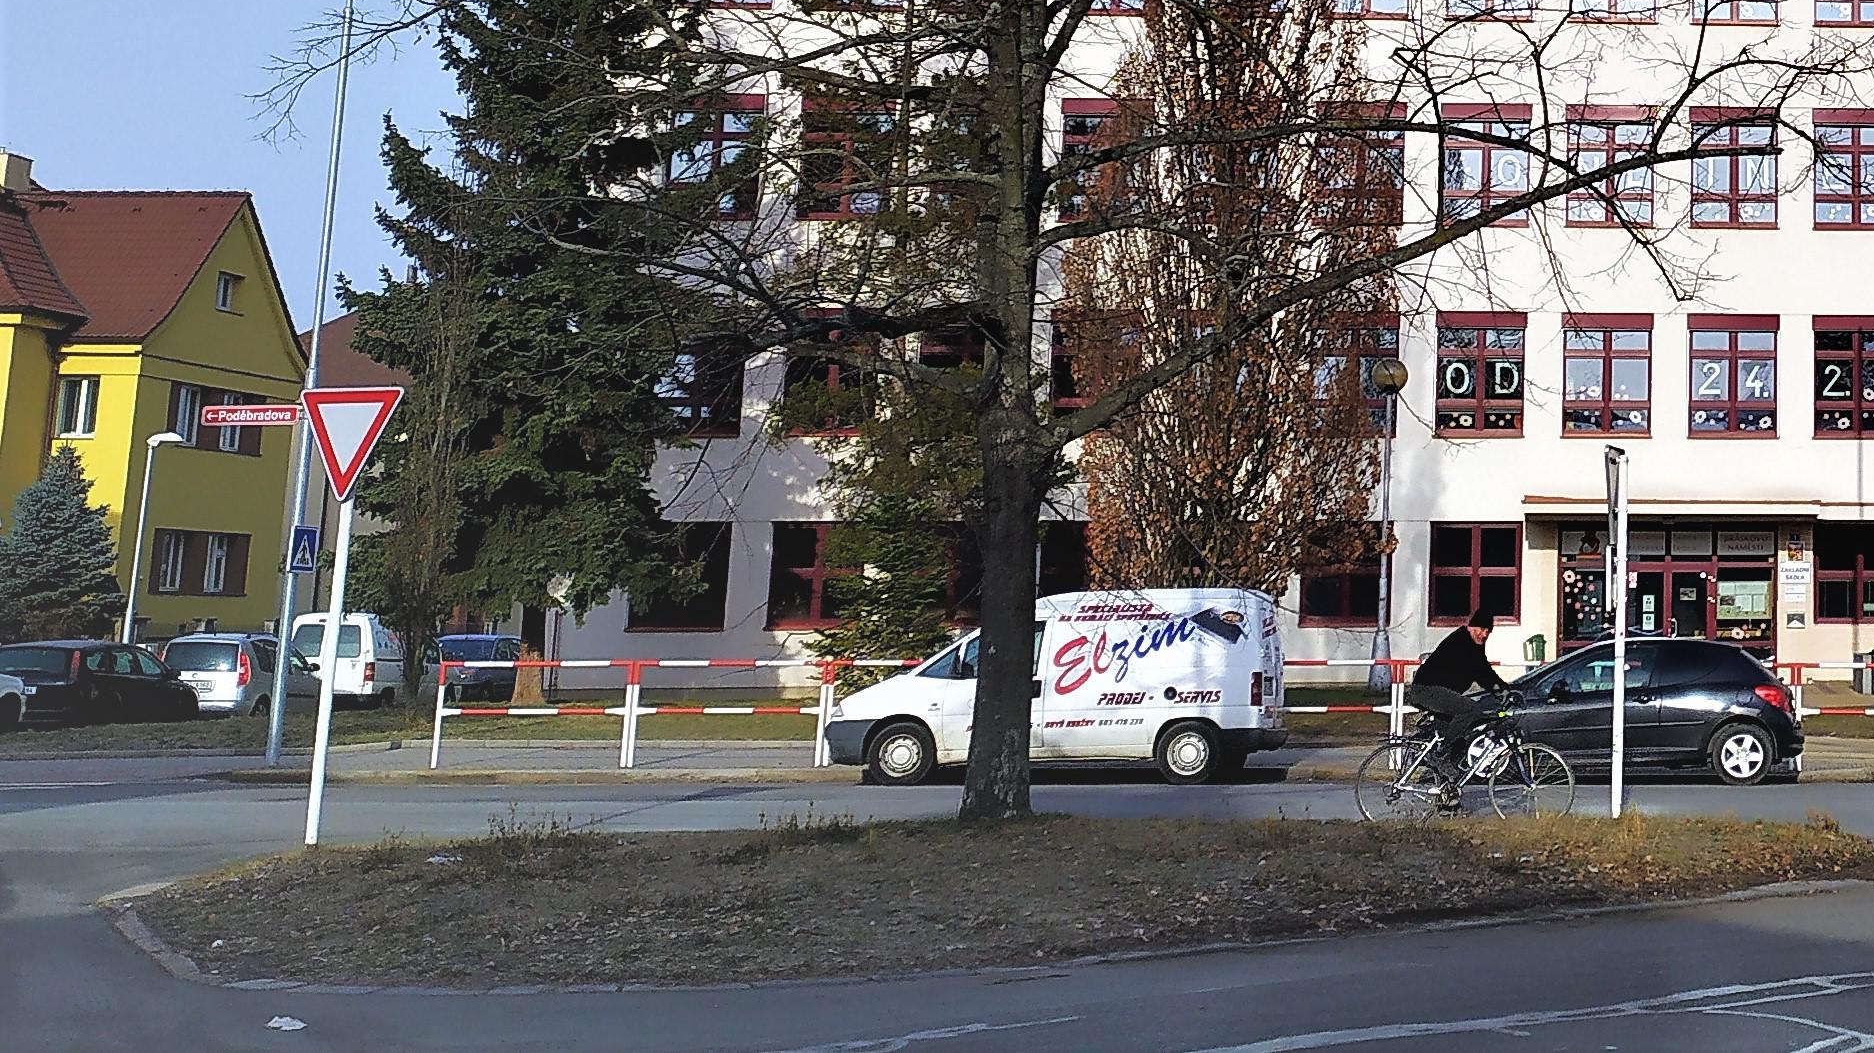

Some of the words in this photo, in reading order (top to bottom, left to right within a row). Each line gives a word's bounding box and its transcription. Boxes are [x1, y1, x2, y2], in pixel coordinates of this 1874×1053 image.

[1445, 362, 1518, 395] OD
[218, 409, 292, 422] Poděbradova
[1053, 617, 1196, 696] Elzim
[1097, 692, 1147, 706] PRODEJ
[1174, 690, 1222, 704] SERVIS
